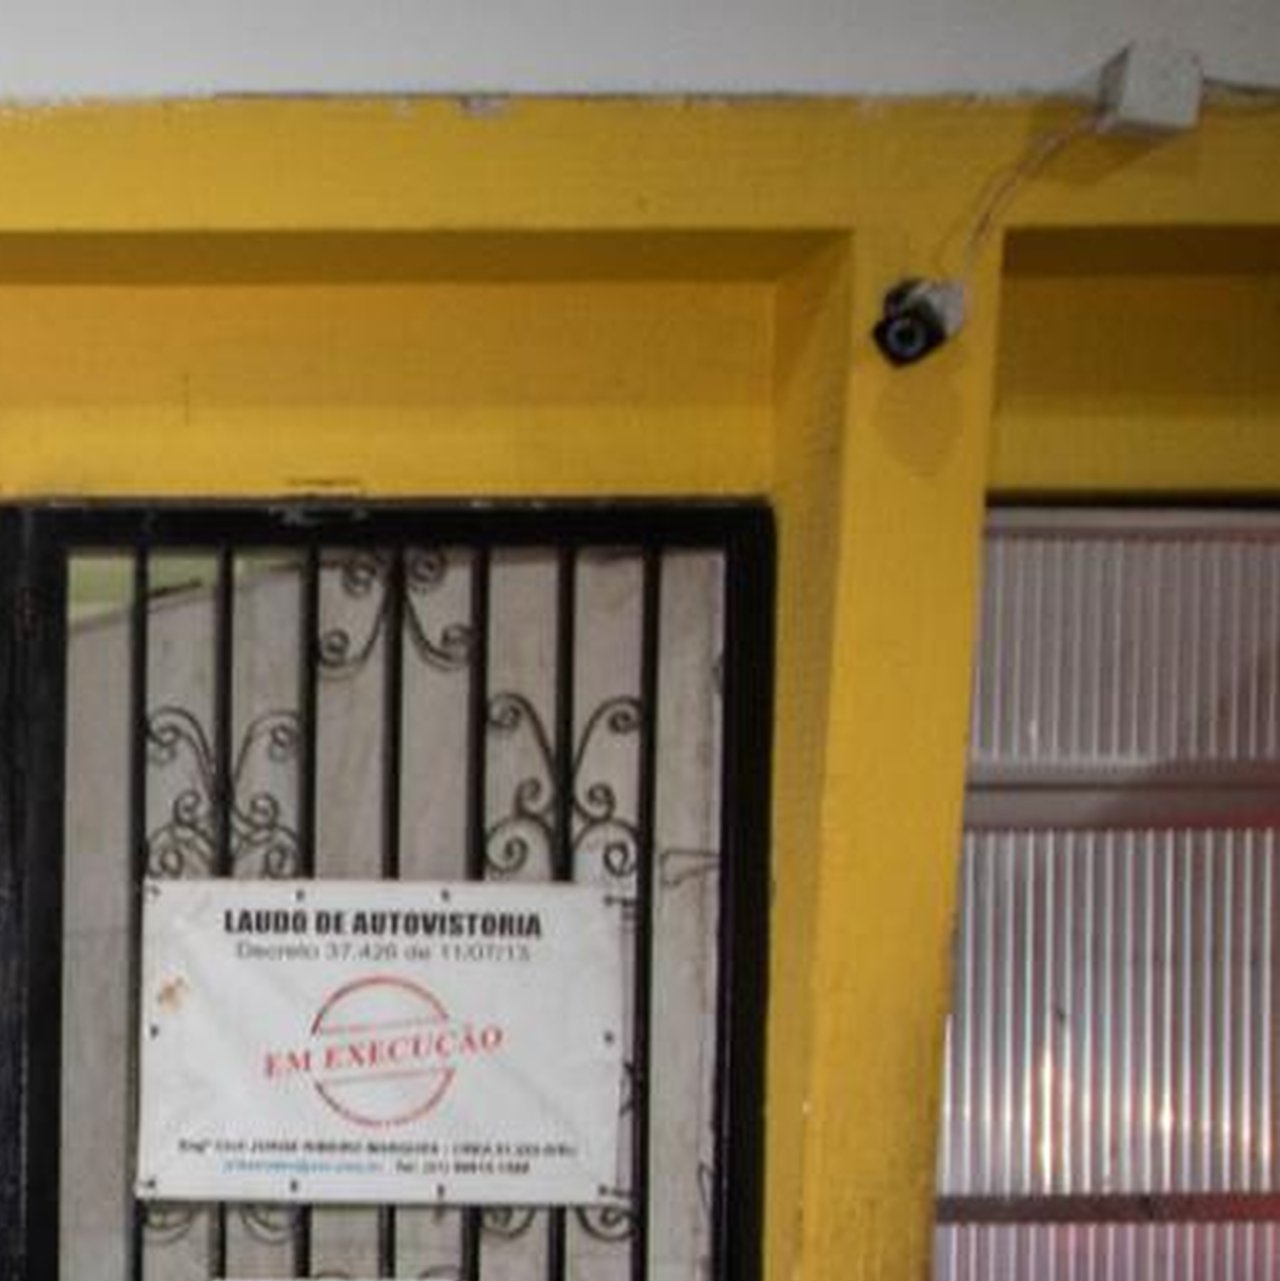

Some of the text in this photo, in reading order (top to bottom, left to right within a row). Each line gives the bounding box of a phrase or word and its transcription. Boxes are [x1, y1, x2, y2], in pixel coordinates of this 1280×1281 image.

[224, 908, 542, 940] LAUDO DE AUTOVISTORIA
[264, 1023, 503, 1079] EM EXECUÇÃO
